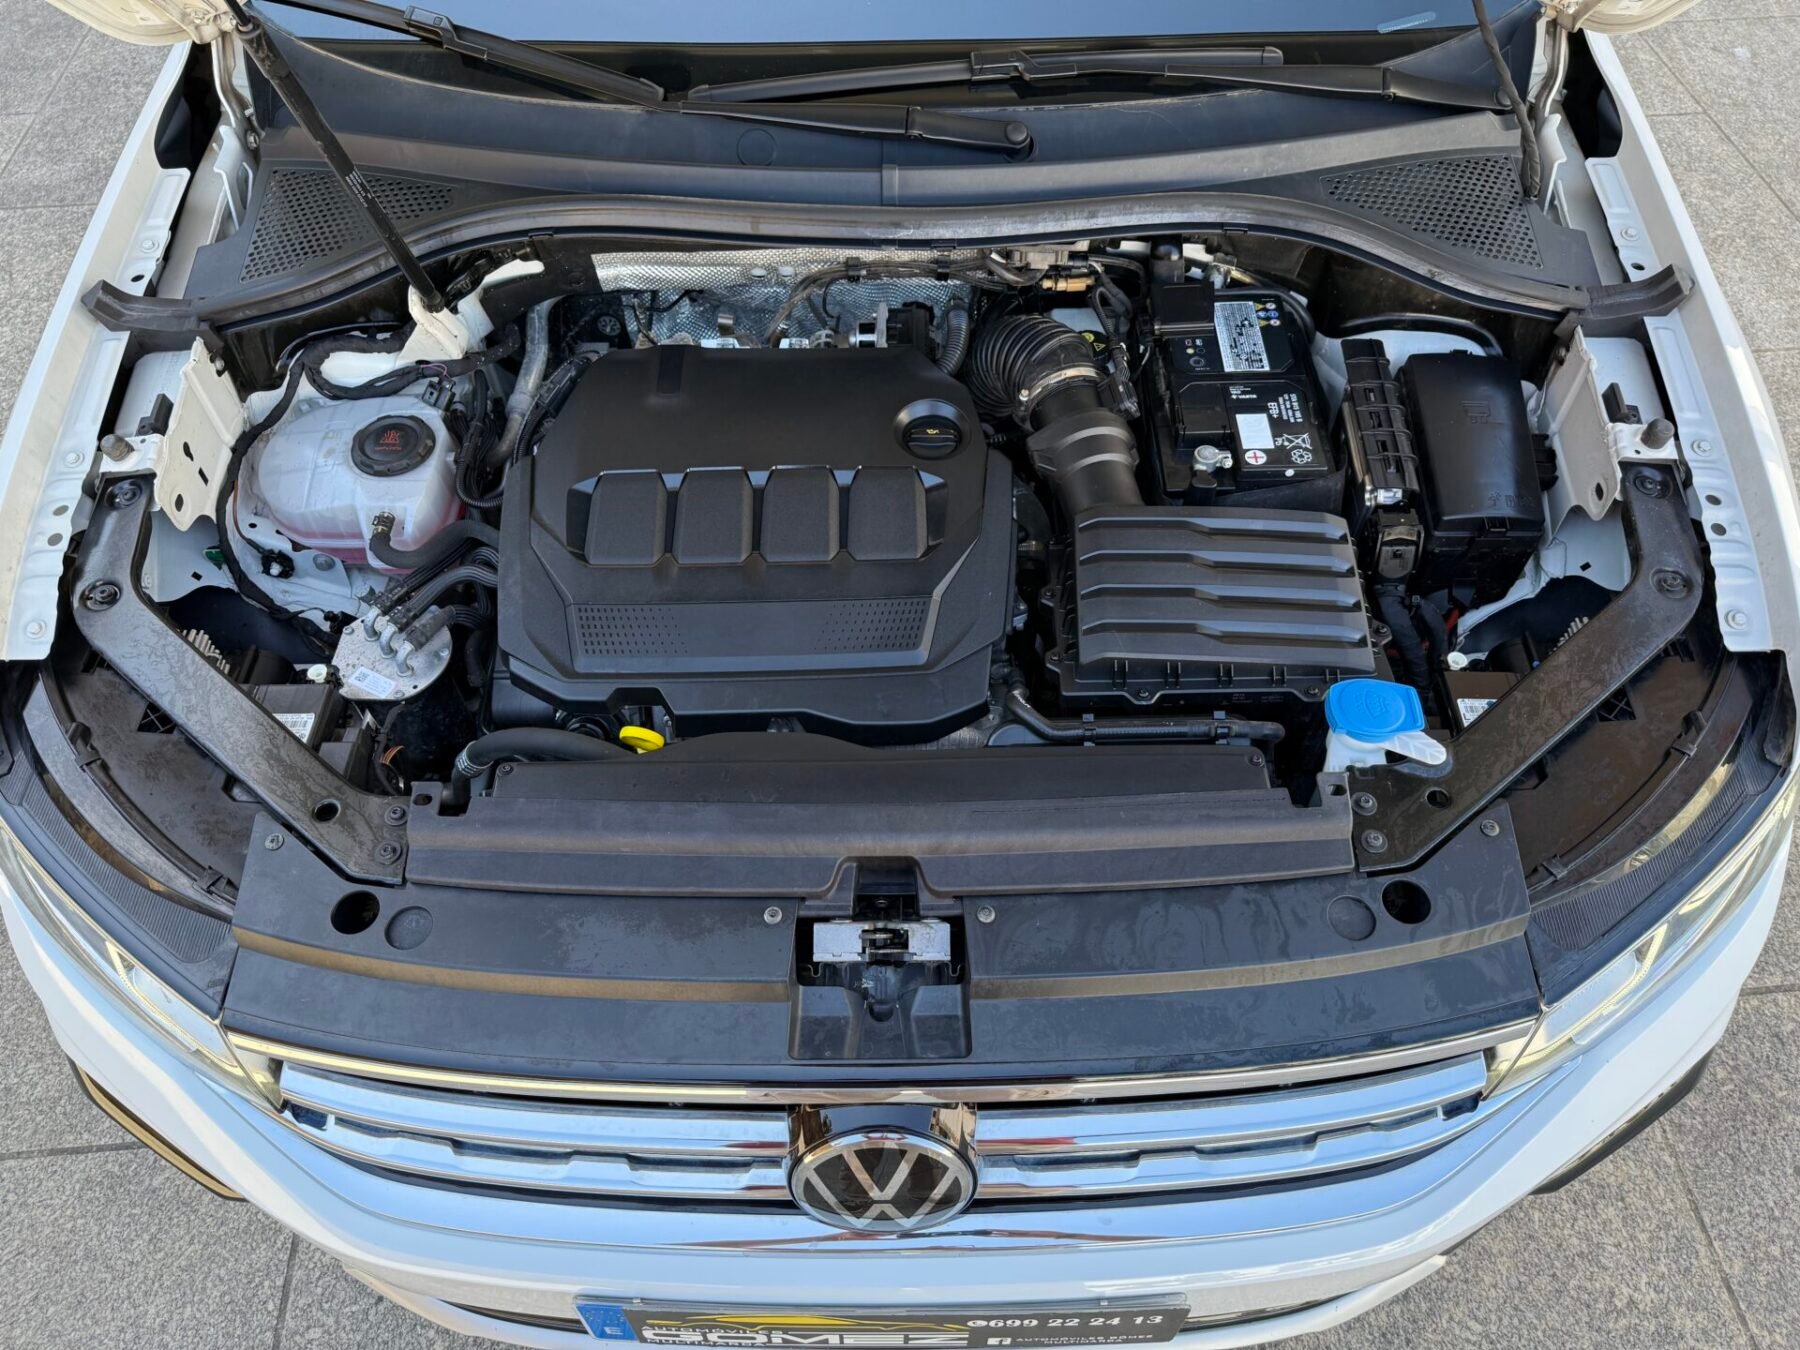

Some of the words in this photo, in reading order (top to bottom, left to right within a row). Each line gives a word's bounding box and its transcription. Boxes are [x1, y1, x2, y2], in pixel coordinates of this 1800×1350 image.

[1267, 402, 1279, 419] EFB+
[988, 1319, 1039, 1328] 699
[1047, 1318, 1080, 1327] 22
[1088, 1317, 1121, 1326] 24
[1133, 1315, 1163, 1324] 13
[641, 1329, 969, 1345] GOMEZ
